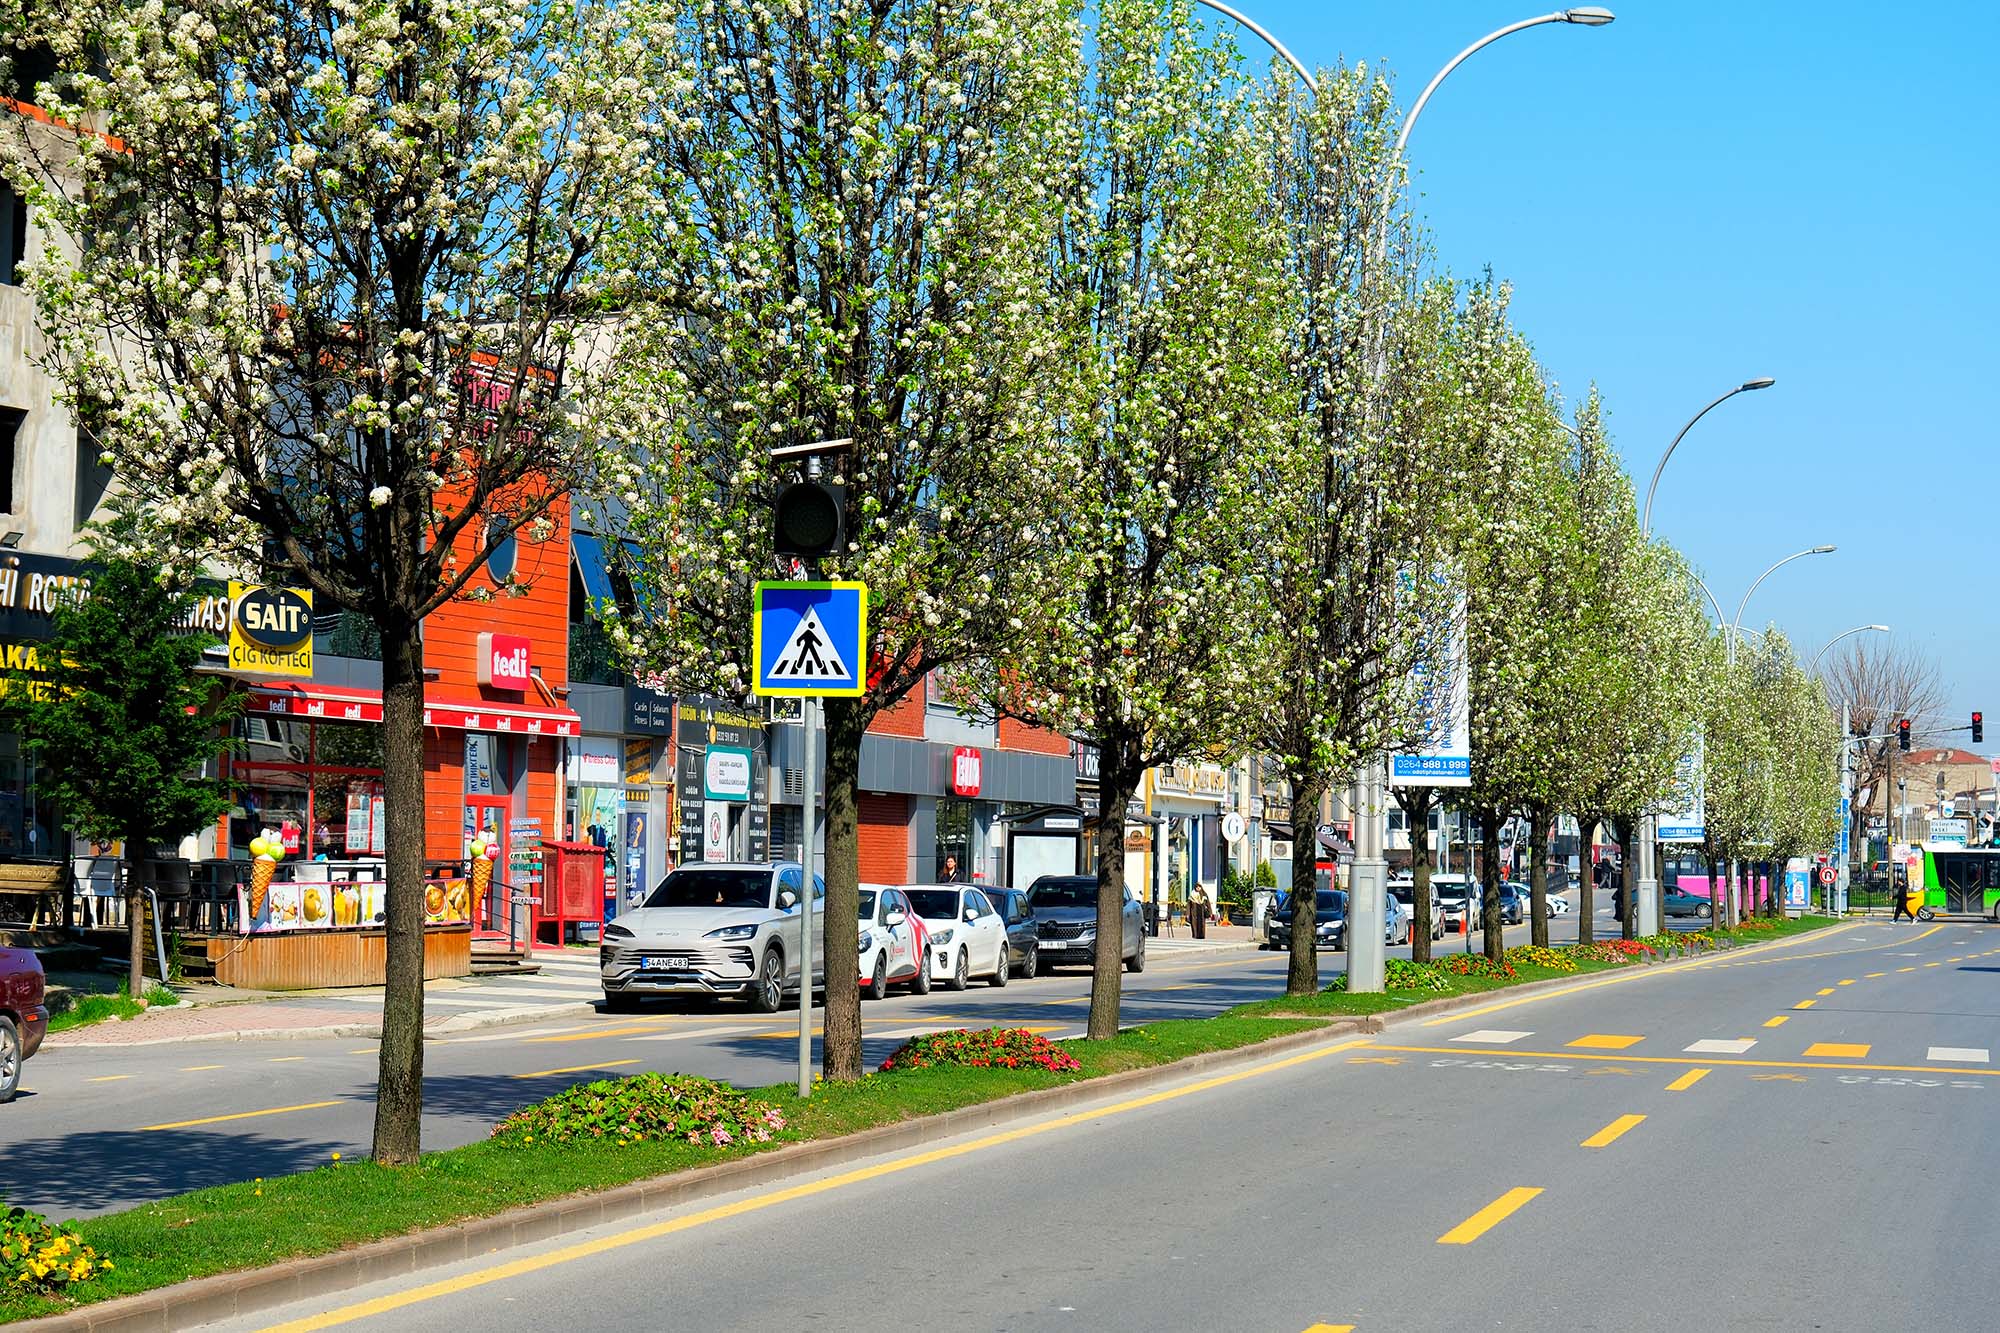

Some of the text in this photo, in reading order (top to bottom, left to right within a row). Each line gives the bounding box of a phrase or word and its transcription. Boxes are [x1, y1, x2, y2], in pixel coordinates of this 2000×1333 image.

[246, 597, 301, 632] SAİT
[233, 644, 311, 669] ÇİĞ KÖFTECİ
[493, 648, 527, 678] tedi
[269, 698, 571, 735] tedi tedi tedi di tedi tedi tedi tedi
[1397, 759, 1420, 769] 0264
[1422, 760, 1441, 769] 888
